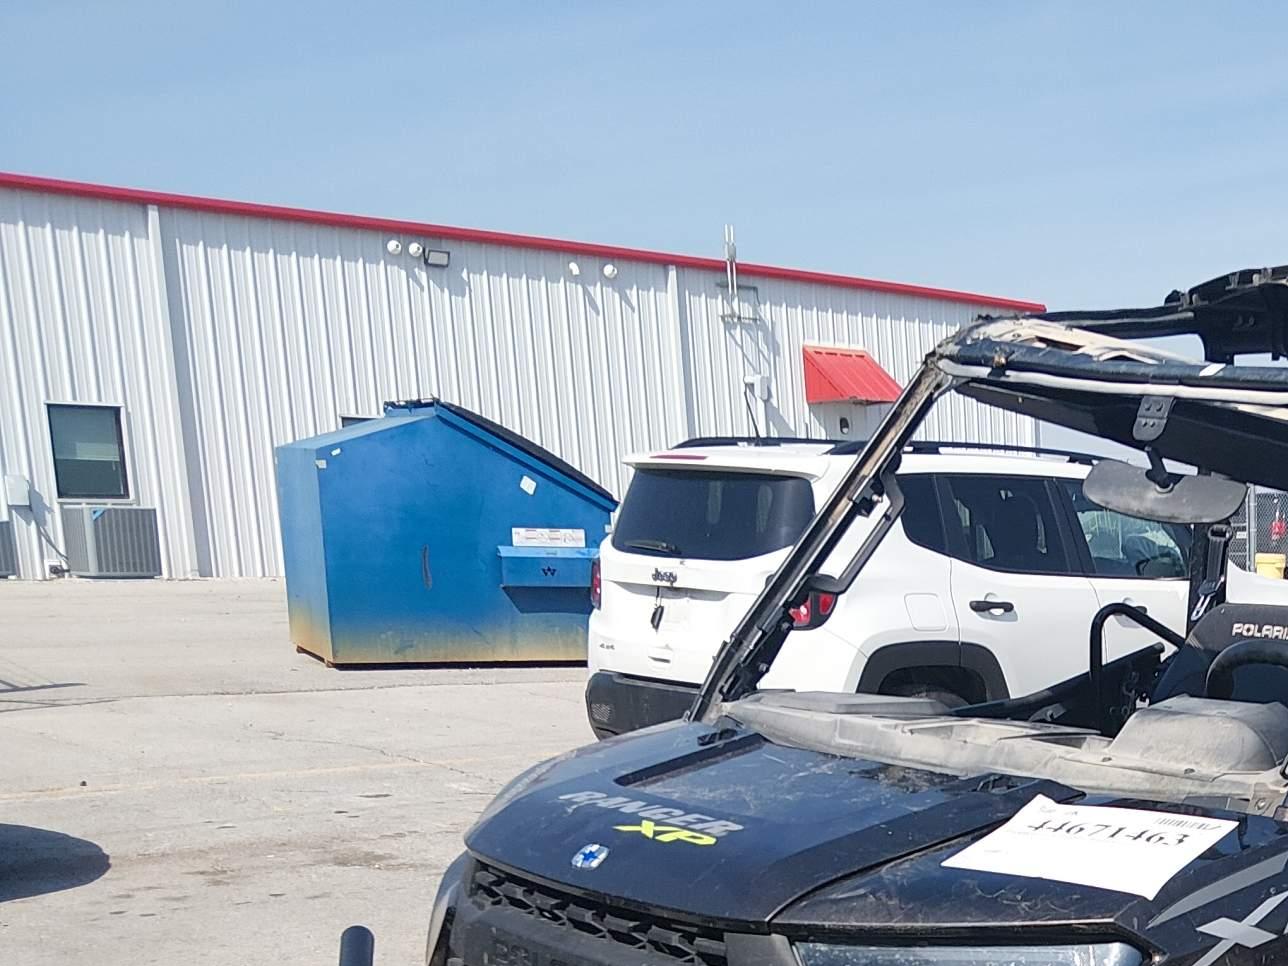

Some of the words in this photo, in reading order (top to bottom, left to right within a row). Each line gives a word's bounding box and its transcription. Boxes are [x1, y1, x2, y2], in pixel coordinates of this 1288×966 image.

[558, 790, 744, 838] RANGER
[612, 820, 718, 846] XP
[1026, 819, 1191, 847] 44671463
